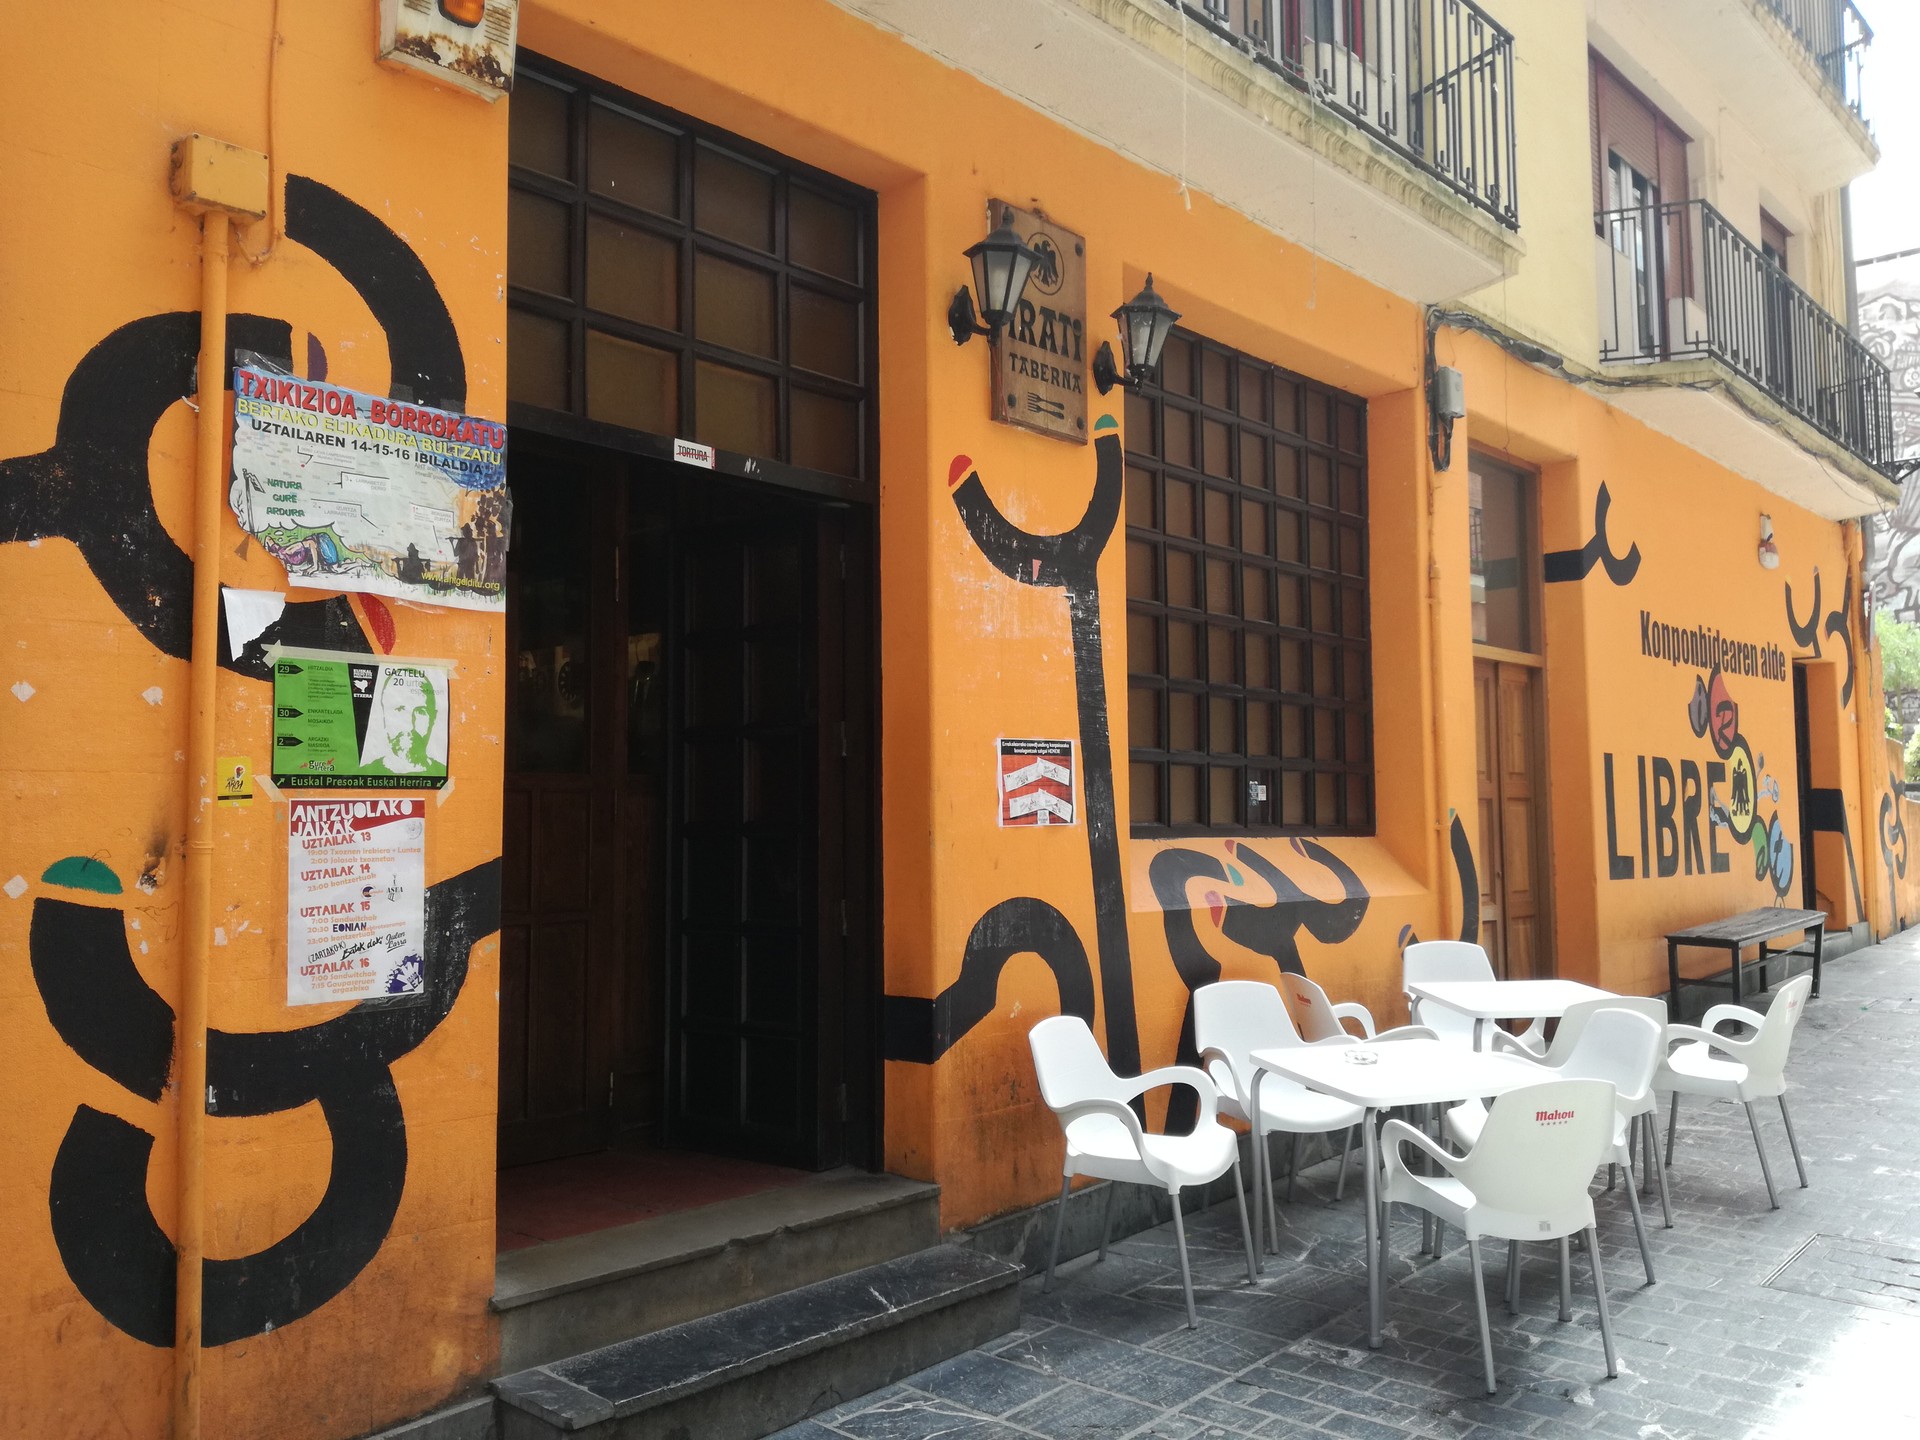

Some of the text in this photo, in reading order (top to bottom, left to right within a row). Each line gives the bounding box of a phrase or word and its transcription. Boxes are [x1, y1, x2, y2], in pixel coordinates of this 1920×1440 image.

[1009, 352, 1081, 394] TABERNA
[240, 369, 504, 449] TXIKIZIOA BORROKATU
[238, 398, 318, 429] BERTAKO
[324, 417, 418, 449] ELIKADURA
[421, 438, 502, 464] BULTZATU
[252, 419, 345, 448] UZTAILAREN
[351, 441, 410, 459] 14-15-16
[414, 452, 482, 474] IBILALDIA
[677, 444, 709, 462] TORTURA
[267, 478, 303, 490] NATURA
[272, 493, 298, 503] GURE
[266, 506, 305, 517] ARDURA
[1640, 609, 1786, 682] Konponbidearen alde
[279, 665, 290, 673] 29
[384, 667, 425, 678] GAZTELU
[393, 678, 404, 687] 20
[279, 709, 290, 717] 30
[278, 738, 284, 746] 2
[291, 776, 432, 787] Euskal Presoak Euskal Herrira
[291, 800, 413, 821] ANTZUOLAKO
[1604, 752, 1730, 880] LIBRE
[291, 818, 356, 836] JAIXAK
[302, 832, 372, 850] UZTAILAK 13
[301, 864, 371, 881] UZTAILAK 14
[308, 882, 329, 892] 23:00
[301, 901, 371, 917] UZTAILAK 15
[311, 917, 329, 925] 7:00
[333, 922, 367, 932] EONIAN
[307, 937, 329, 945] 23:00
[301, 957, 370, 976] UZTAILAK 16
[311, 981, 325, 989] 7:15
[1536, 1109, 1575, 1121] Mahou
